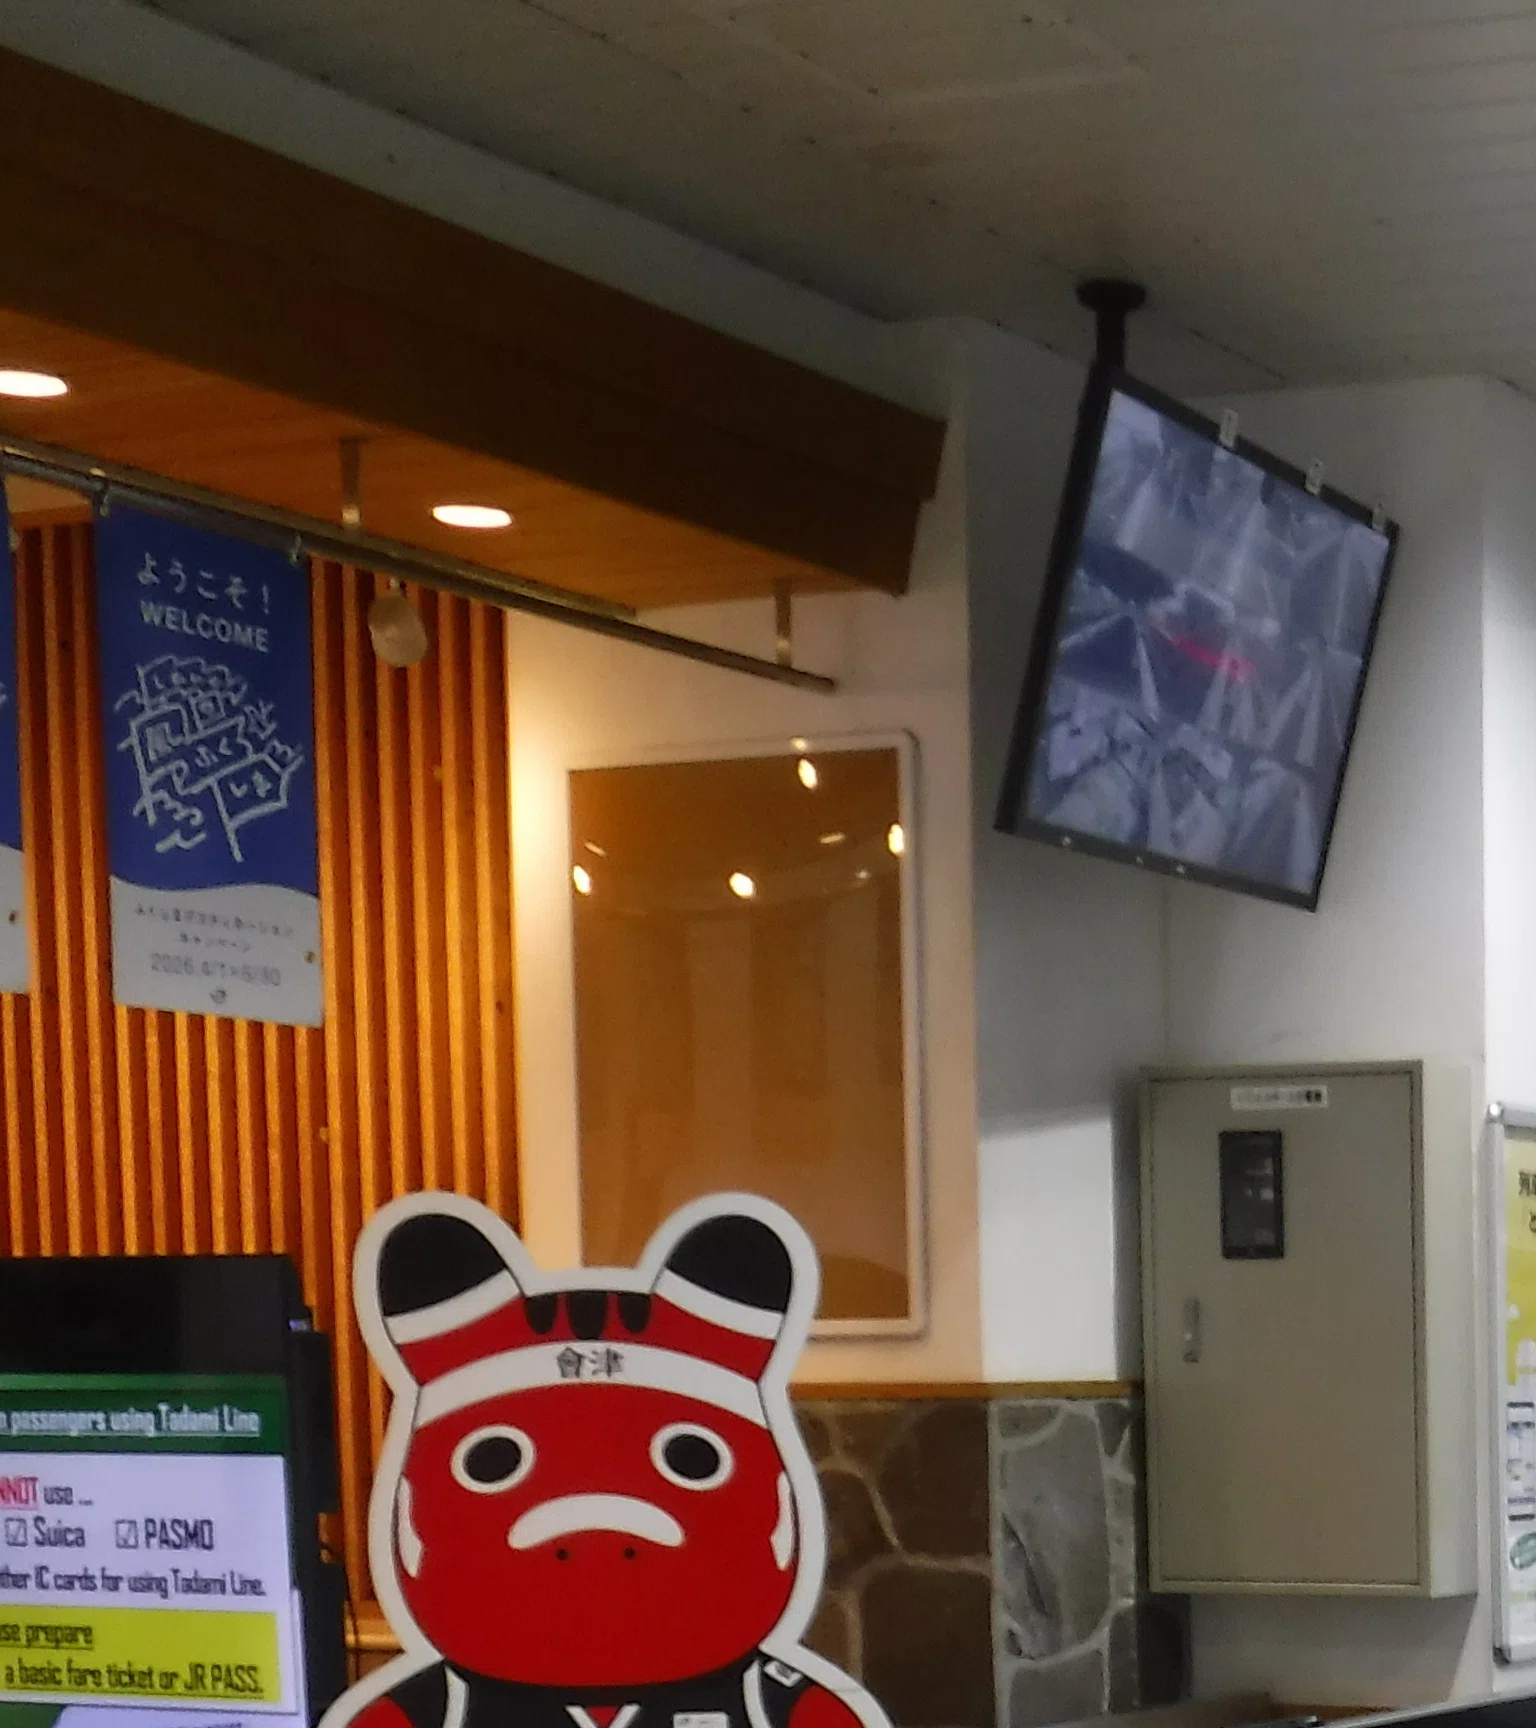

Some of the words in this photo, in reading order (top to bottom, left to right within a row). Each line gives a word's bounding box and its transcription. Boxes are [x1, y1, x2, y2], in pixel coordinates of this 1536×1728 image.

[140, 600, 268, 652] WELCOME
[33, 1516, 85, 1547] Suica
[144, 1519, 214, 1550] PASMO
